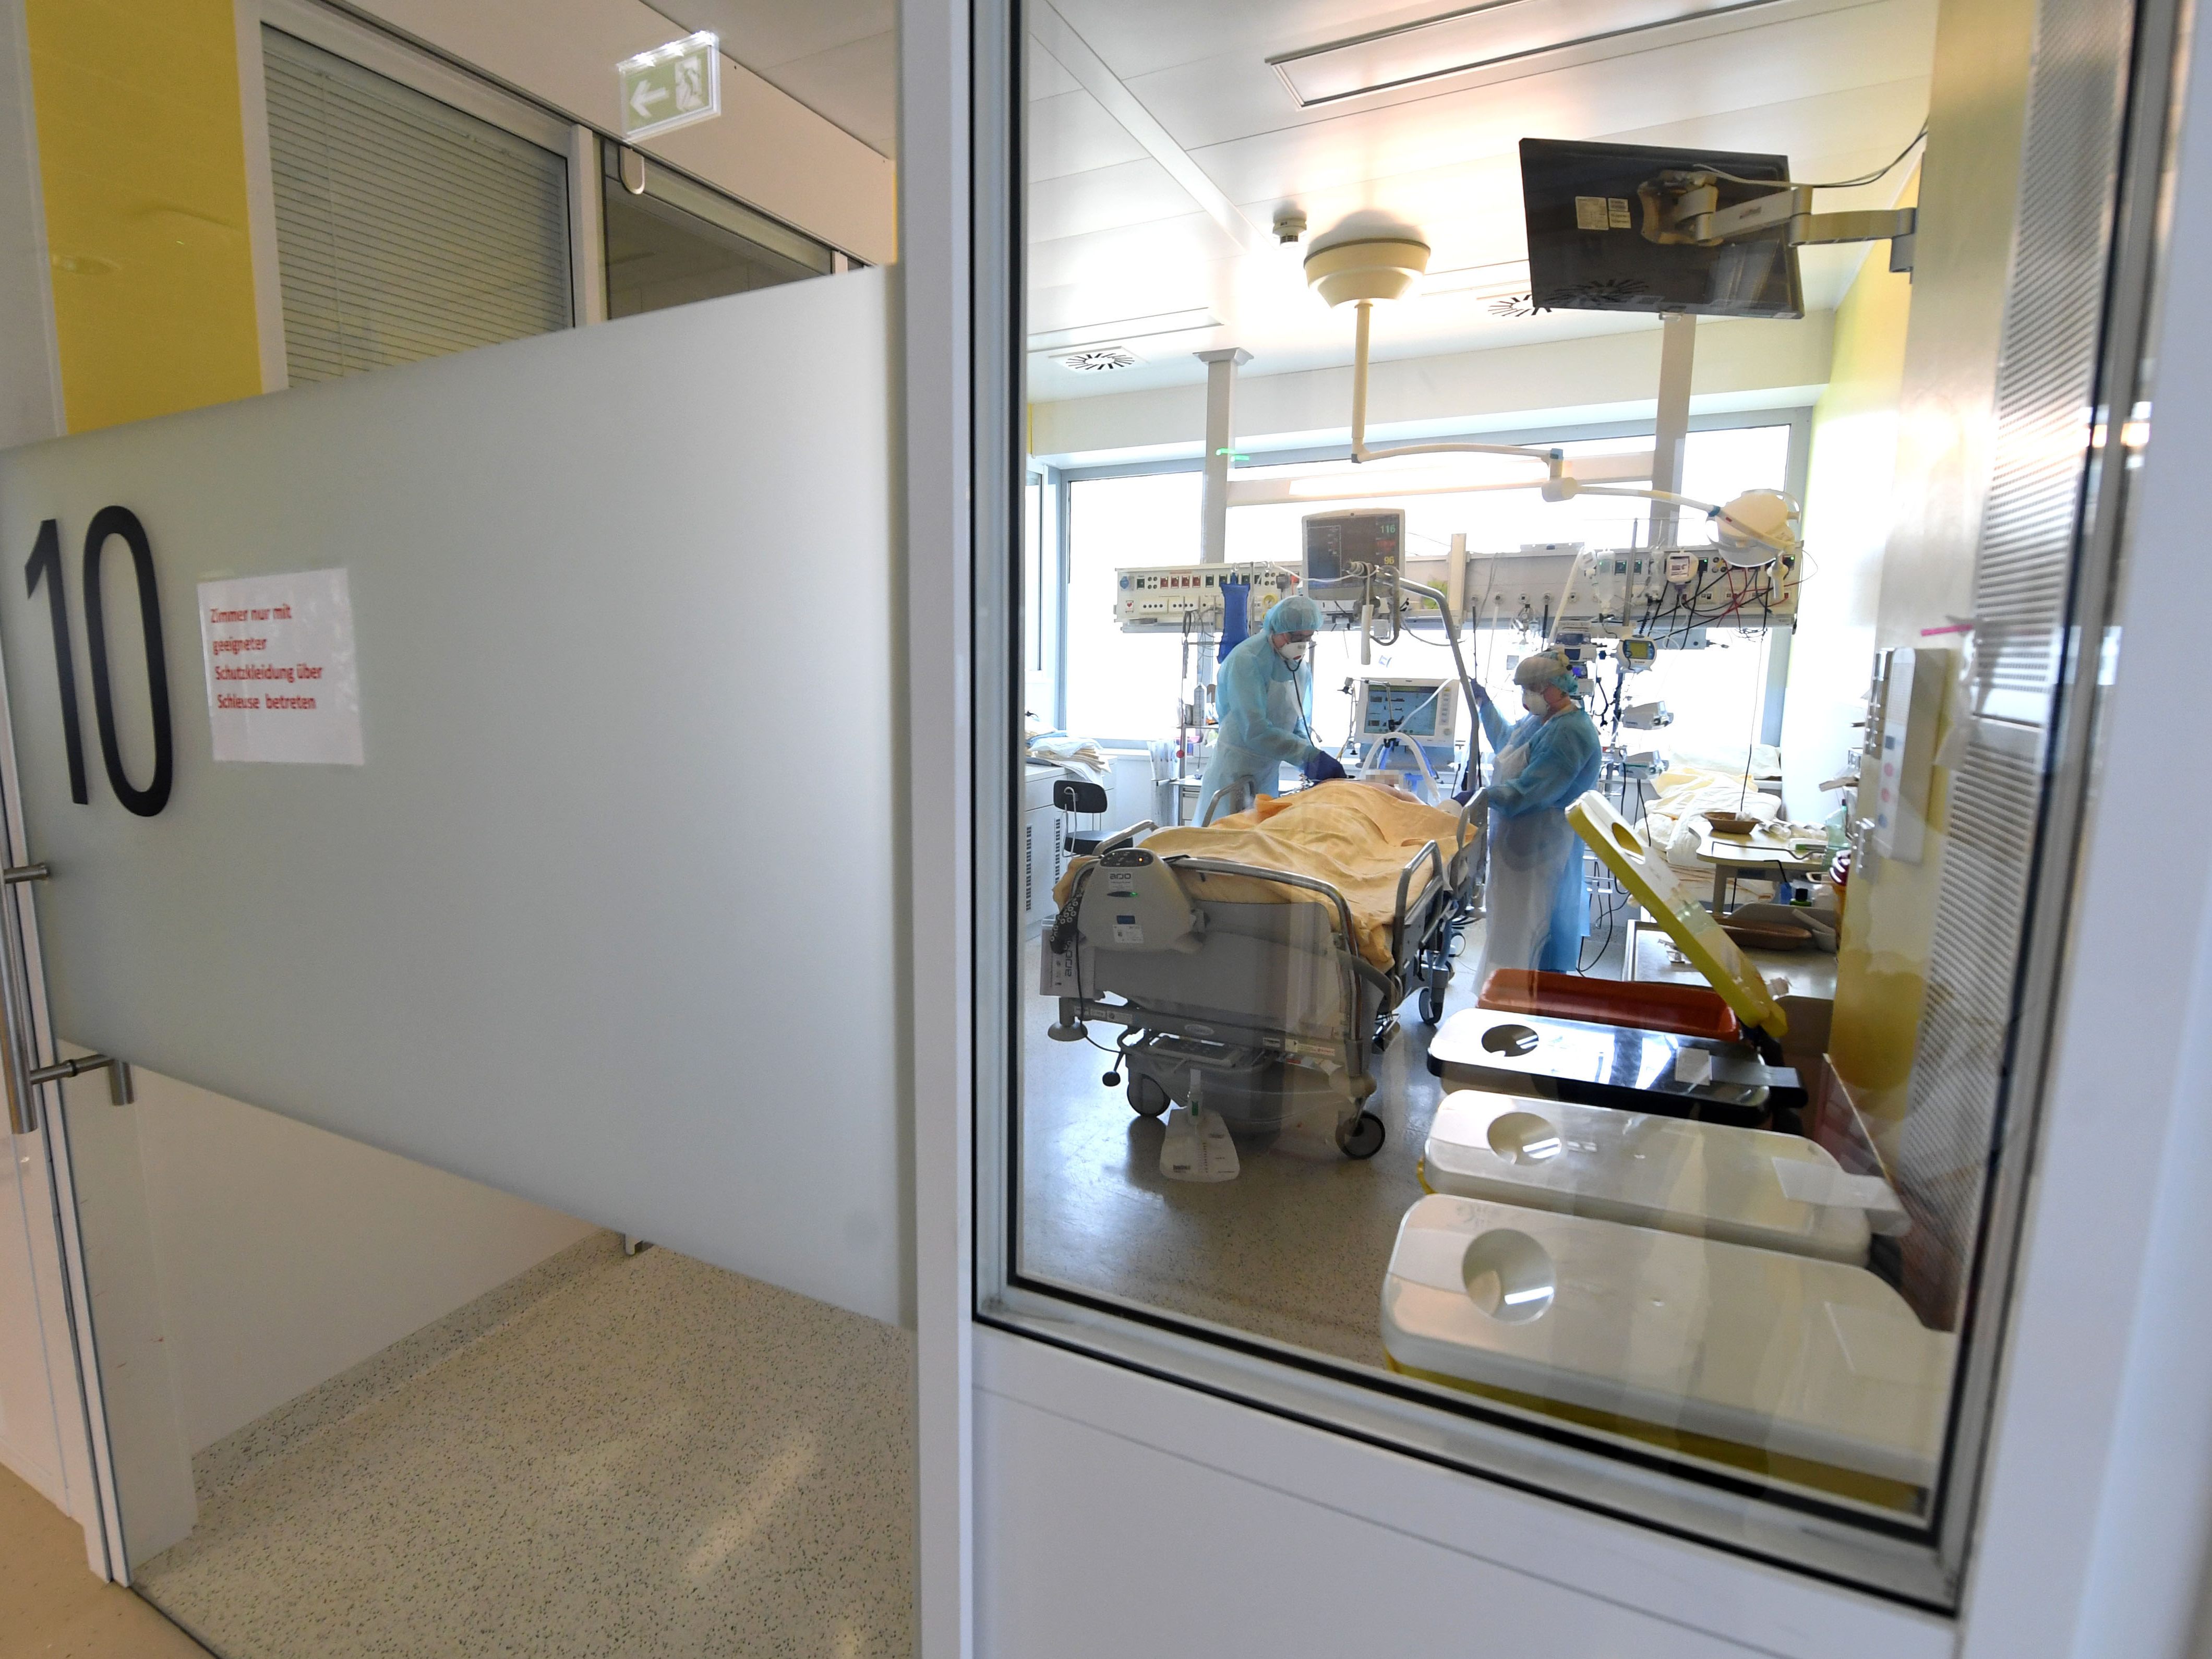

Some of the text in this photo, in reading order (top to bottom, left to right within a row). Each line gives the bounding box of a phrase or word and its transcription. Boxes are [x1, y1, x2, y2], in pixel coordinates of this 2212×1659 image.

[1381, 525, 1396, 534] 116
[211, 603, 292, 623] Zimmer nur mit
[213, 637, 267, 655] geeigneter
[25, 504, 172, 816] 10
[215, 663, 322, 683] Schutzkleidung über
[218, 693, 316, 710] Schleuse betreten
